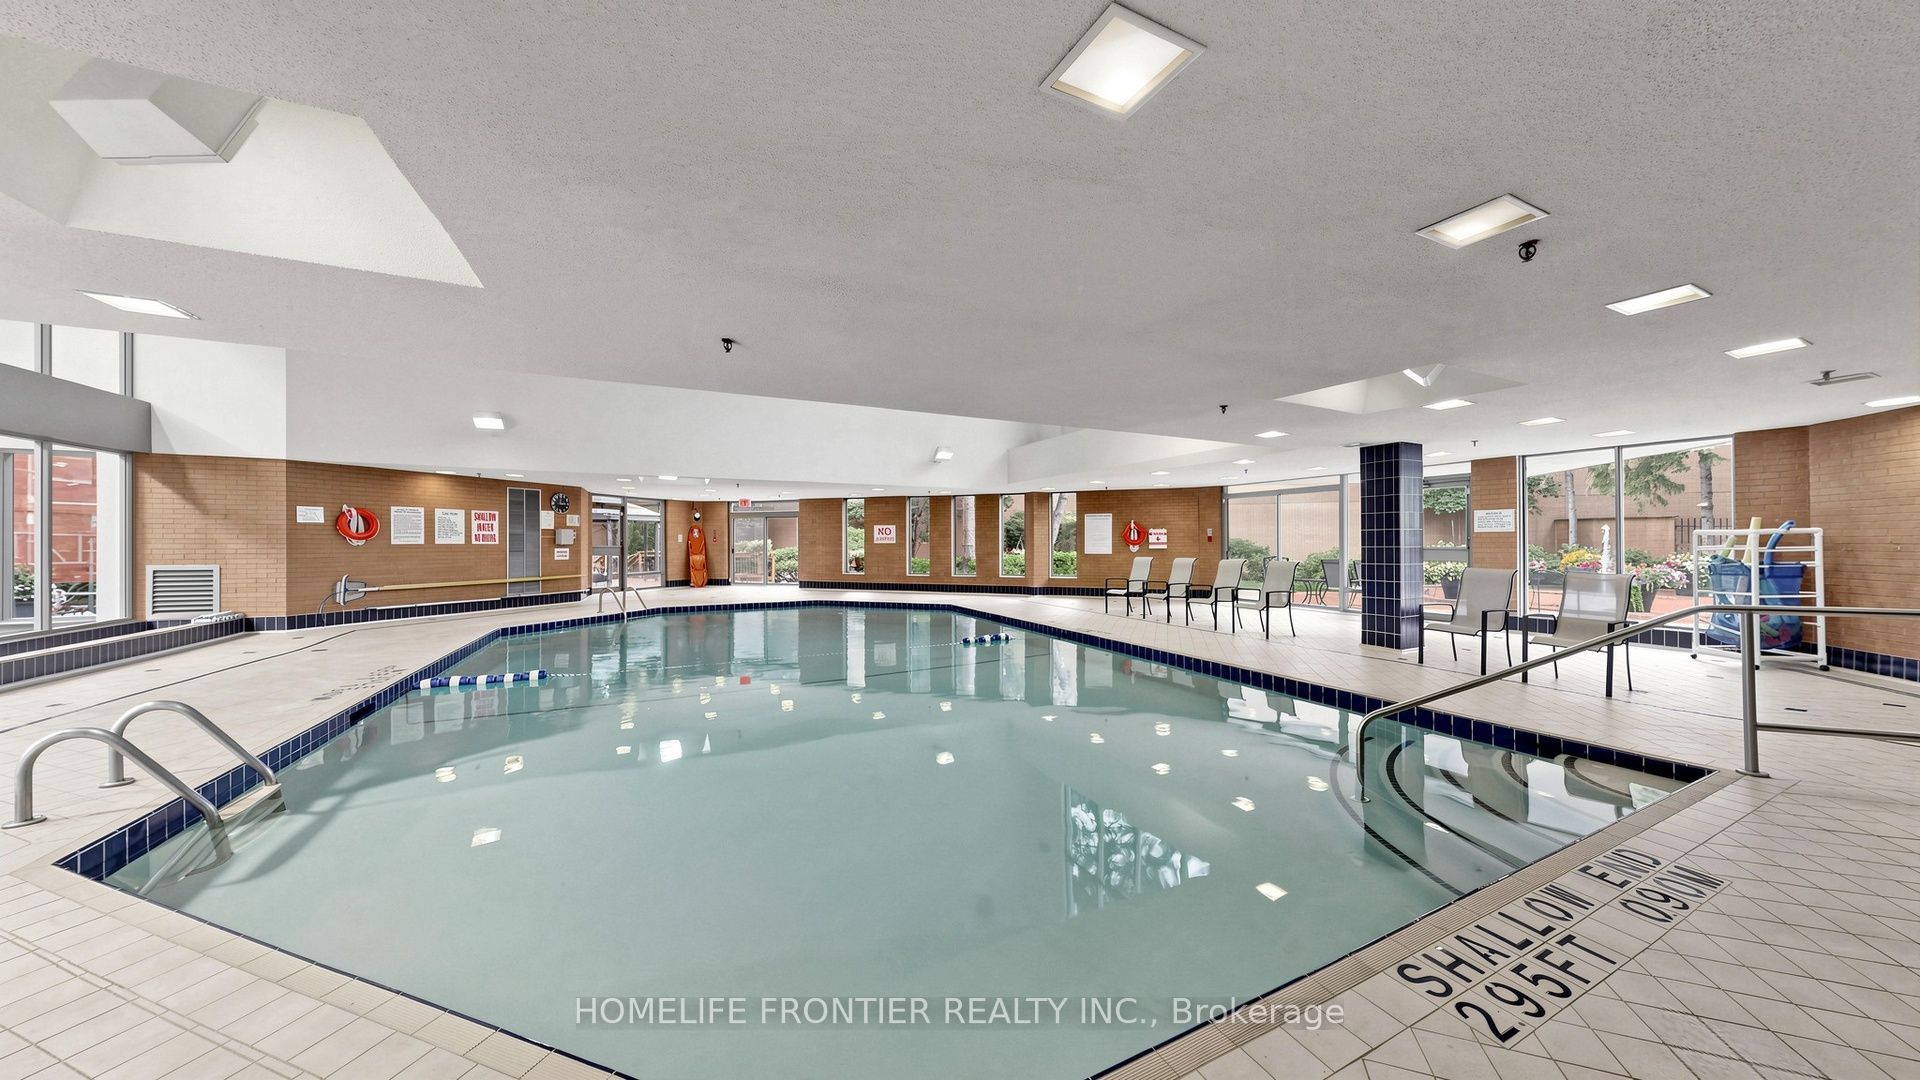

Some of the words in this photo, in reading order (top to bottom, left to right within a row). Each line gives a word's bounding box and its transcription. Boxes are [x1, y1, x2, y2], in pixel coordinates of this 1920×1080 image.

[878, 527, 892, 536] NO
[1396, 883, 1595, 999] SHALLOW
[1577, 848, 1663, 890] END
